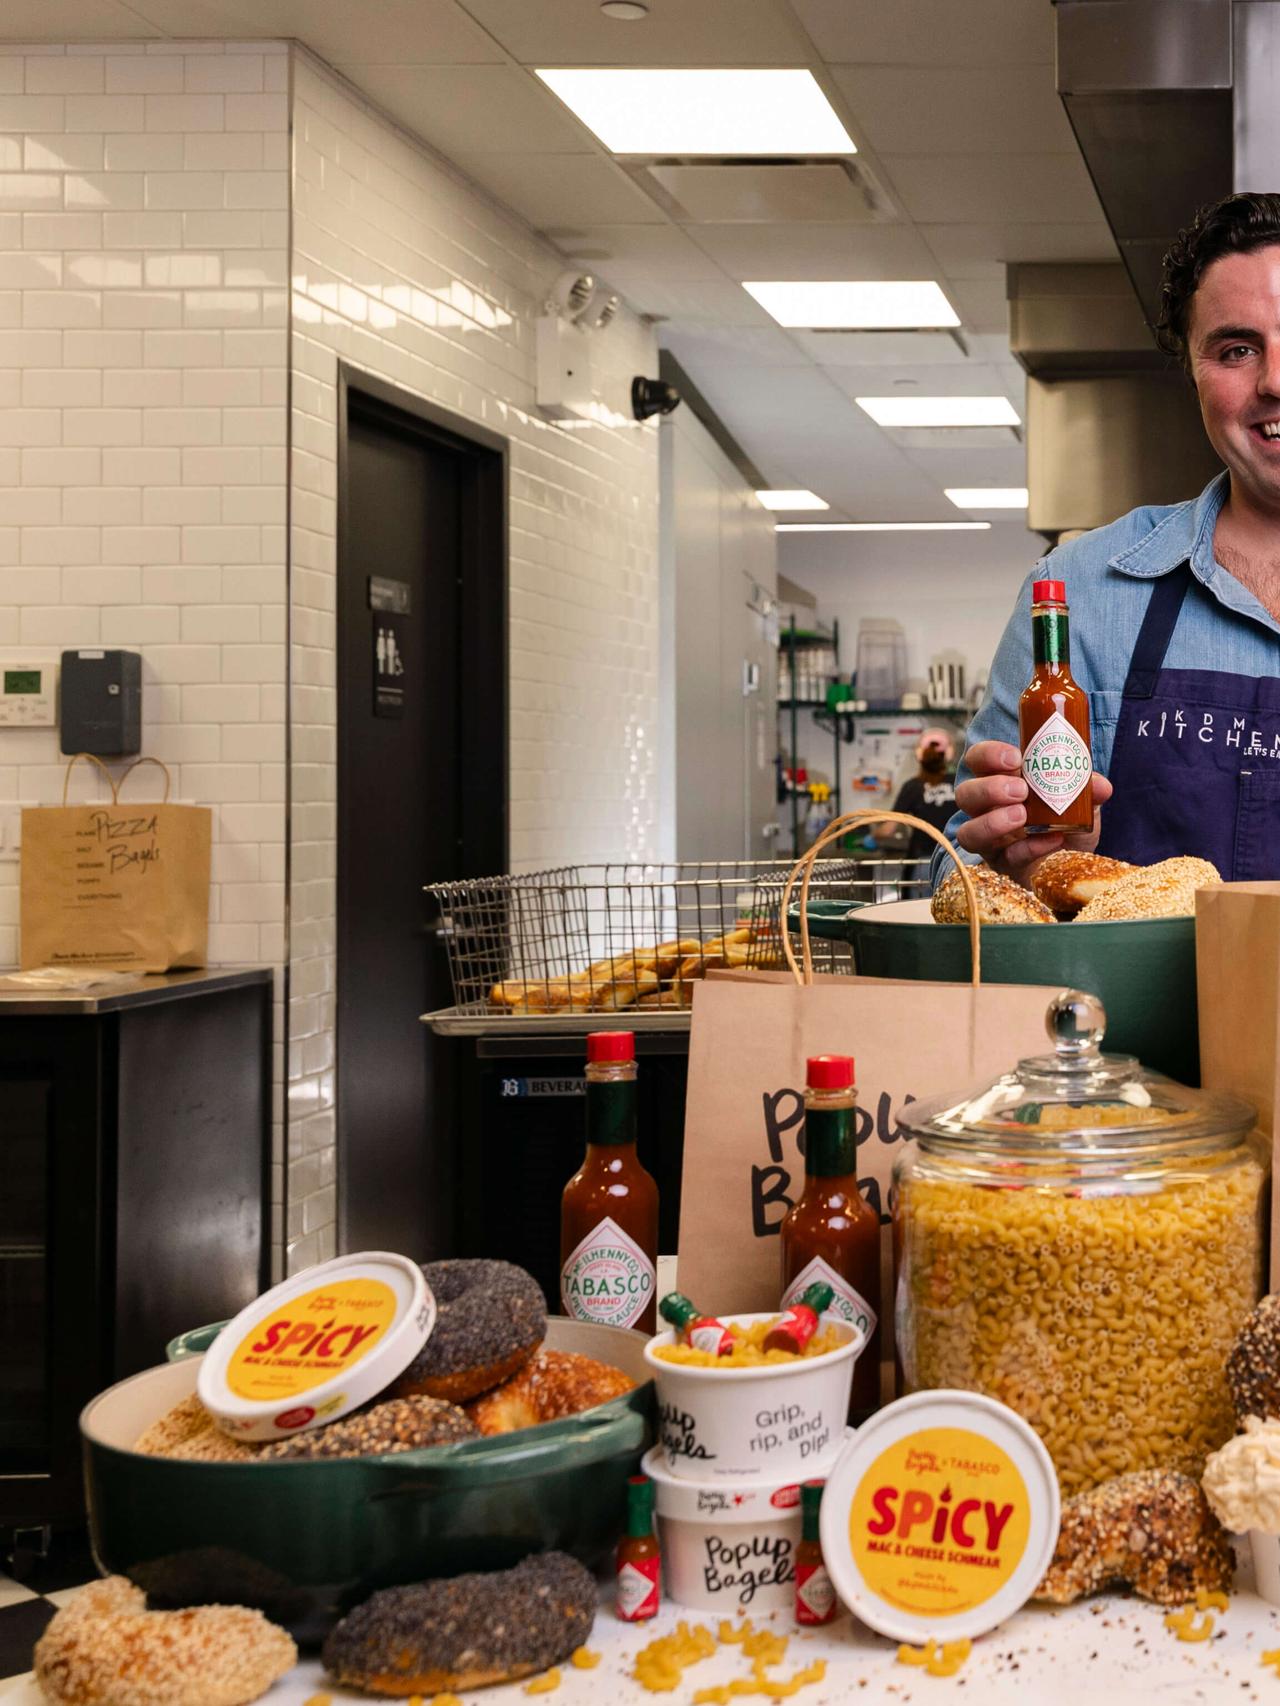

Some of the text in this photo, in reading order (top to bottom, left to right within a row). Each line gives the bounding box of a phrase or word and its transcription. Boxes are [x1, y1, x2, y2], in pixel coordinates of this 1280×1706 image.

[1243, 747, 1267, 756] LET'S
[1025, 756, 1089, 772] TABASCO
[1033, 772, 1082, 793] PEPPER SAUCE
[531, 1080, 587, 1092] BEVERA
[563, 1272, 651, 1296] TABASCO
[587, 1297, 621, 1306] BRAND
[756, 1403, 806, 1428] Grip,
[788, 1410, 823, 1442] and
[662, 1434, 717, 1466] gels
[867, 1541, 892, 1556] MAC
[905, 1545, 945, 1563] CHEESE
[948, 1551, 1000, 1569] SCHMEAR
